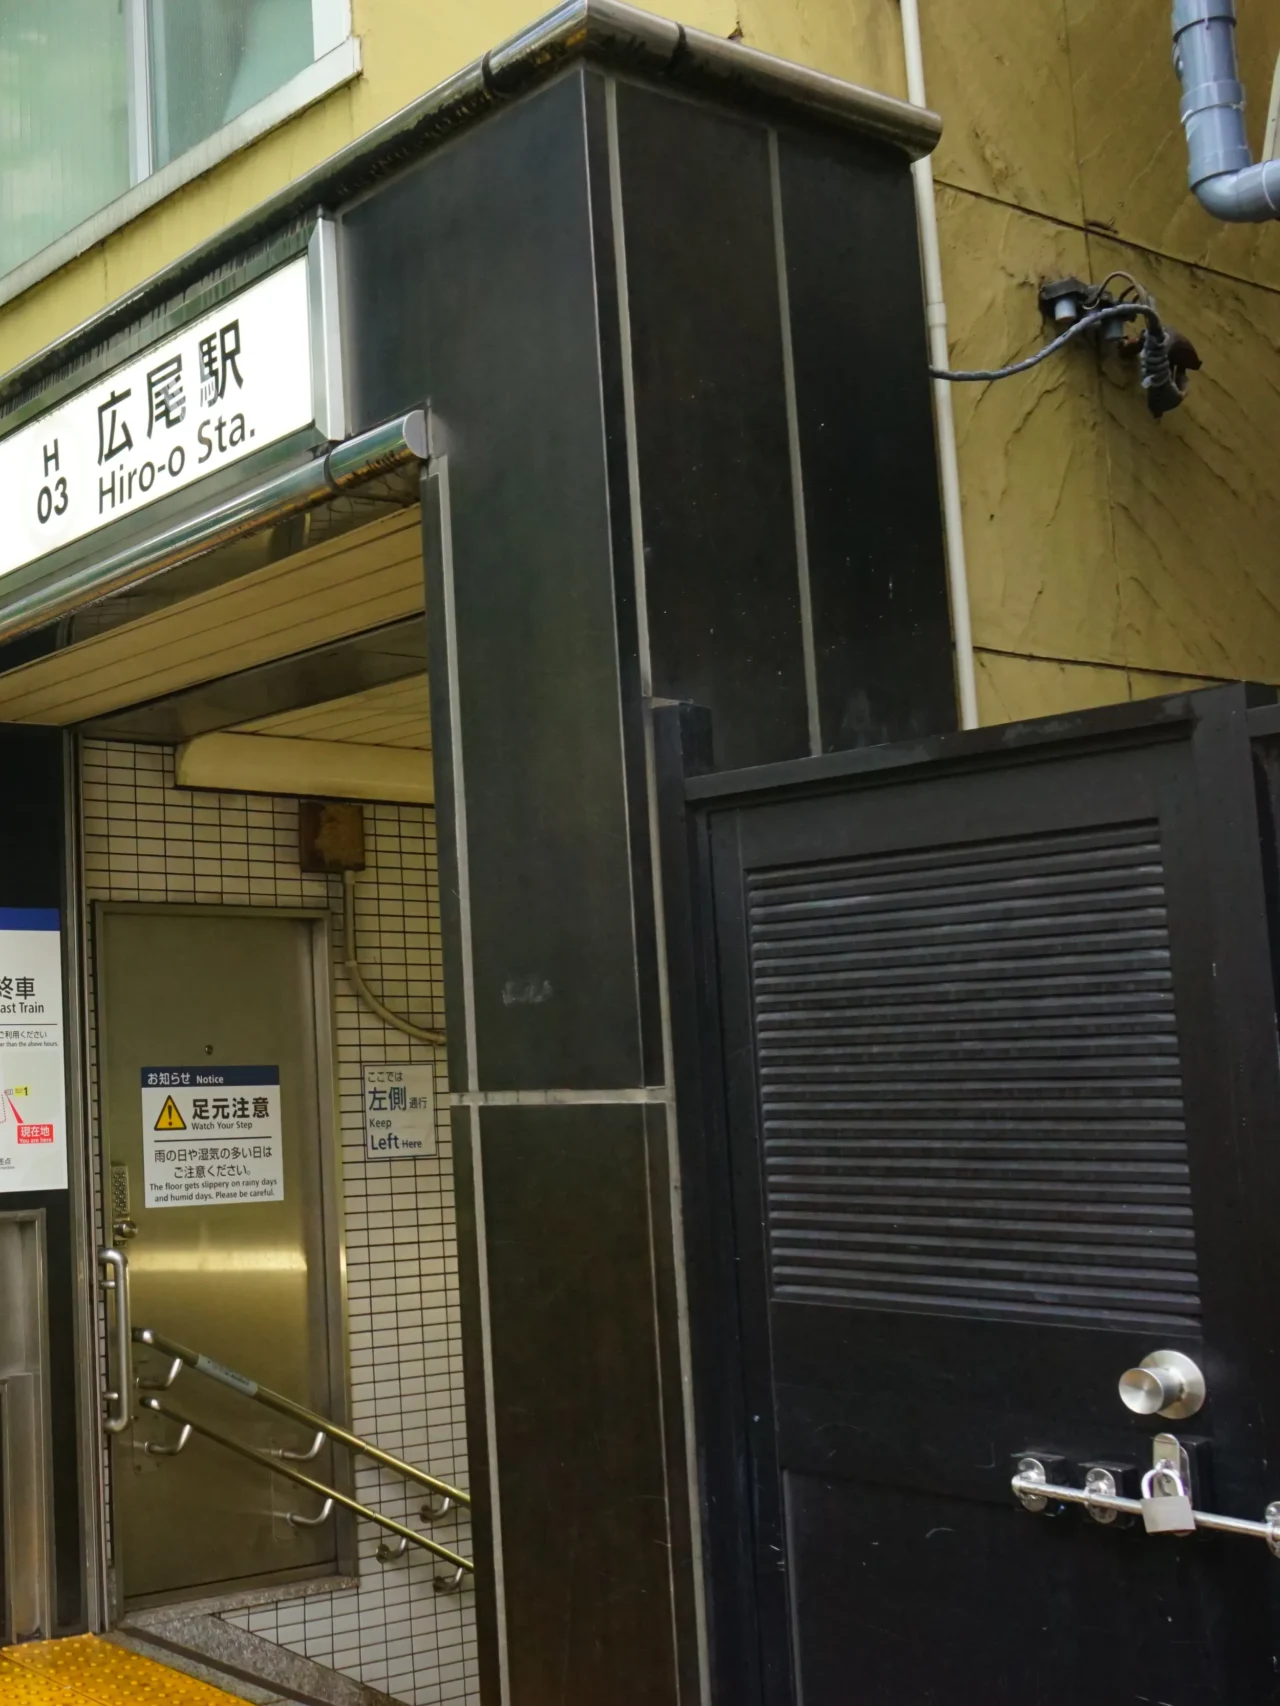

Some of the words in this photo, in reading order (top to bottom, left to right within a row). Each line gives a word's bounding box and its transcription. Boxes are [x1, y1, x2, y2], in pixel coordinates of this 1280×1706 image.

[98, 319, 244, 466] 広尾駅
[43, 438, 60, 478] H
[98, 445, 185, 515] Hiro-o
[198, 411, 255, 464] Sta.
[37, 476, 69, 525] 03
[19, 1002, 44, 1013] Train
[148, 1072, 190, 1085] お知らせ
[196, 1075, 224, 1084] Notice
[368, 1071, 403, 1083] ここでは
[368, 1086, 407, 1111] 左側
[409, 1097, 428, 1109] 通行
[192, 1097, 270, 1120] 足元注意
[191, 1122, 214, 1130] Watch
[236, 1121, 253, 1130] Step
[369, 1118, 392, 1129] Keep
[21, 1126, 50, 1138] 現在地
[371, 1133, 400, 1150] Left
[402, 1139, 422, 1149] Here
[154, 1146, 272, 1163] 雨の日や湿気の多い日は
[174, 1164, 251, 1179] ご注意ください。
[150, 1183, 163, 1191] The
[165, 1183, 182, 1191] floor
[184, 1183, 200, 1191] gets
[201, 1180, 229, 1190] slippery
[242, 1179, 259, 1188] rainy
[261, 1178, 277, 1186] days
[154, 1194, 169, 1202] and
[170, 1193, 194, 1202] humid
[195, 1192, 214, 1201] days.
[215, 1191, 238, 1199] Please
[249, 1188, 275, 1197] careful.
